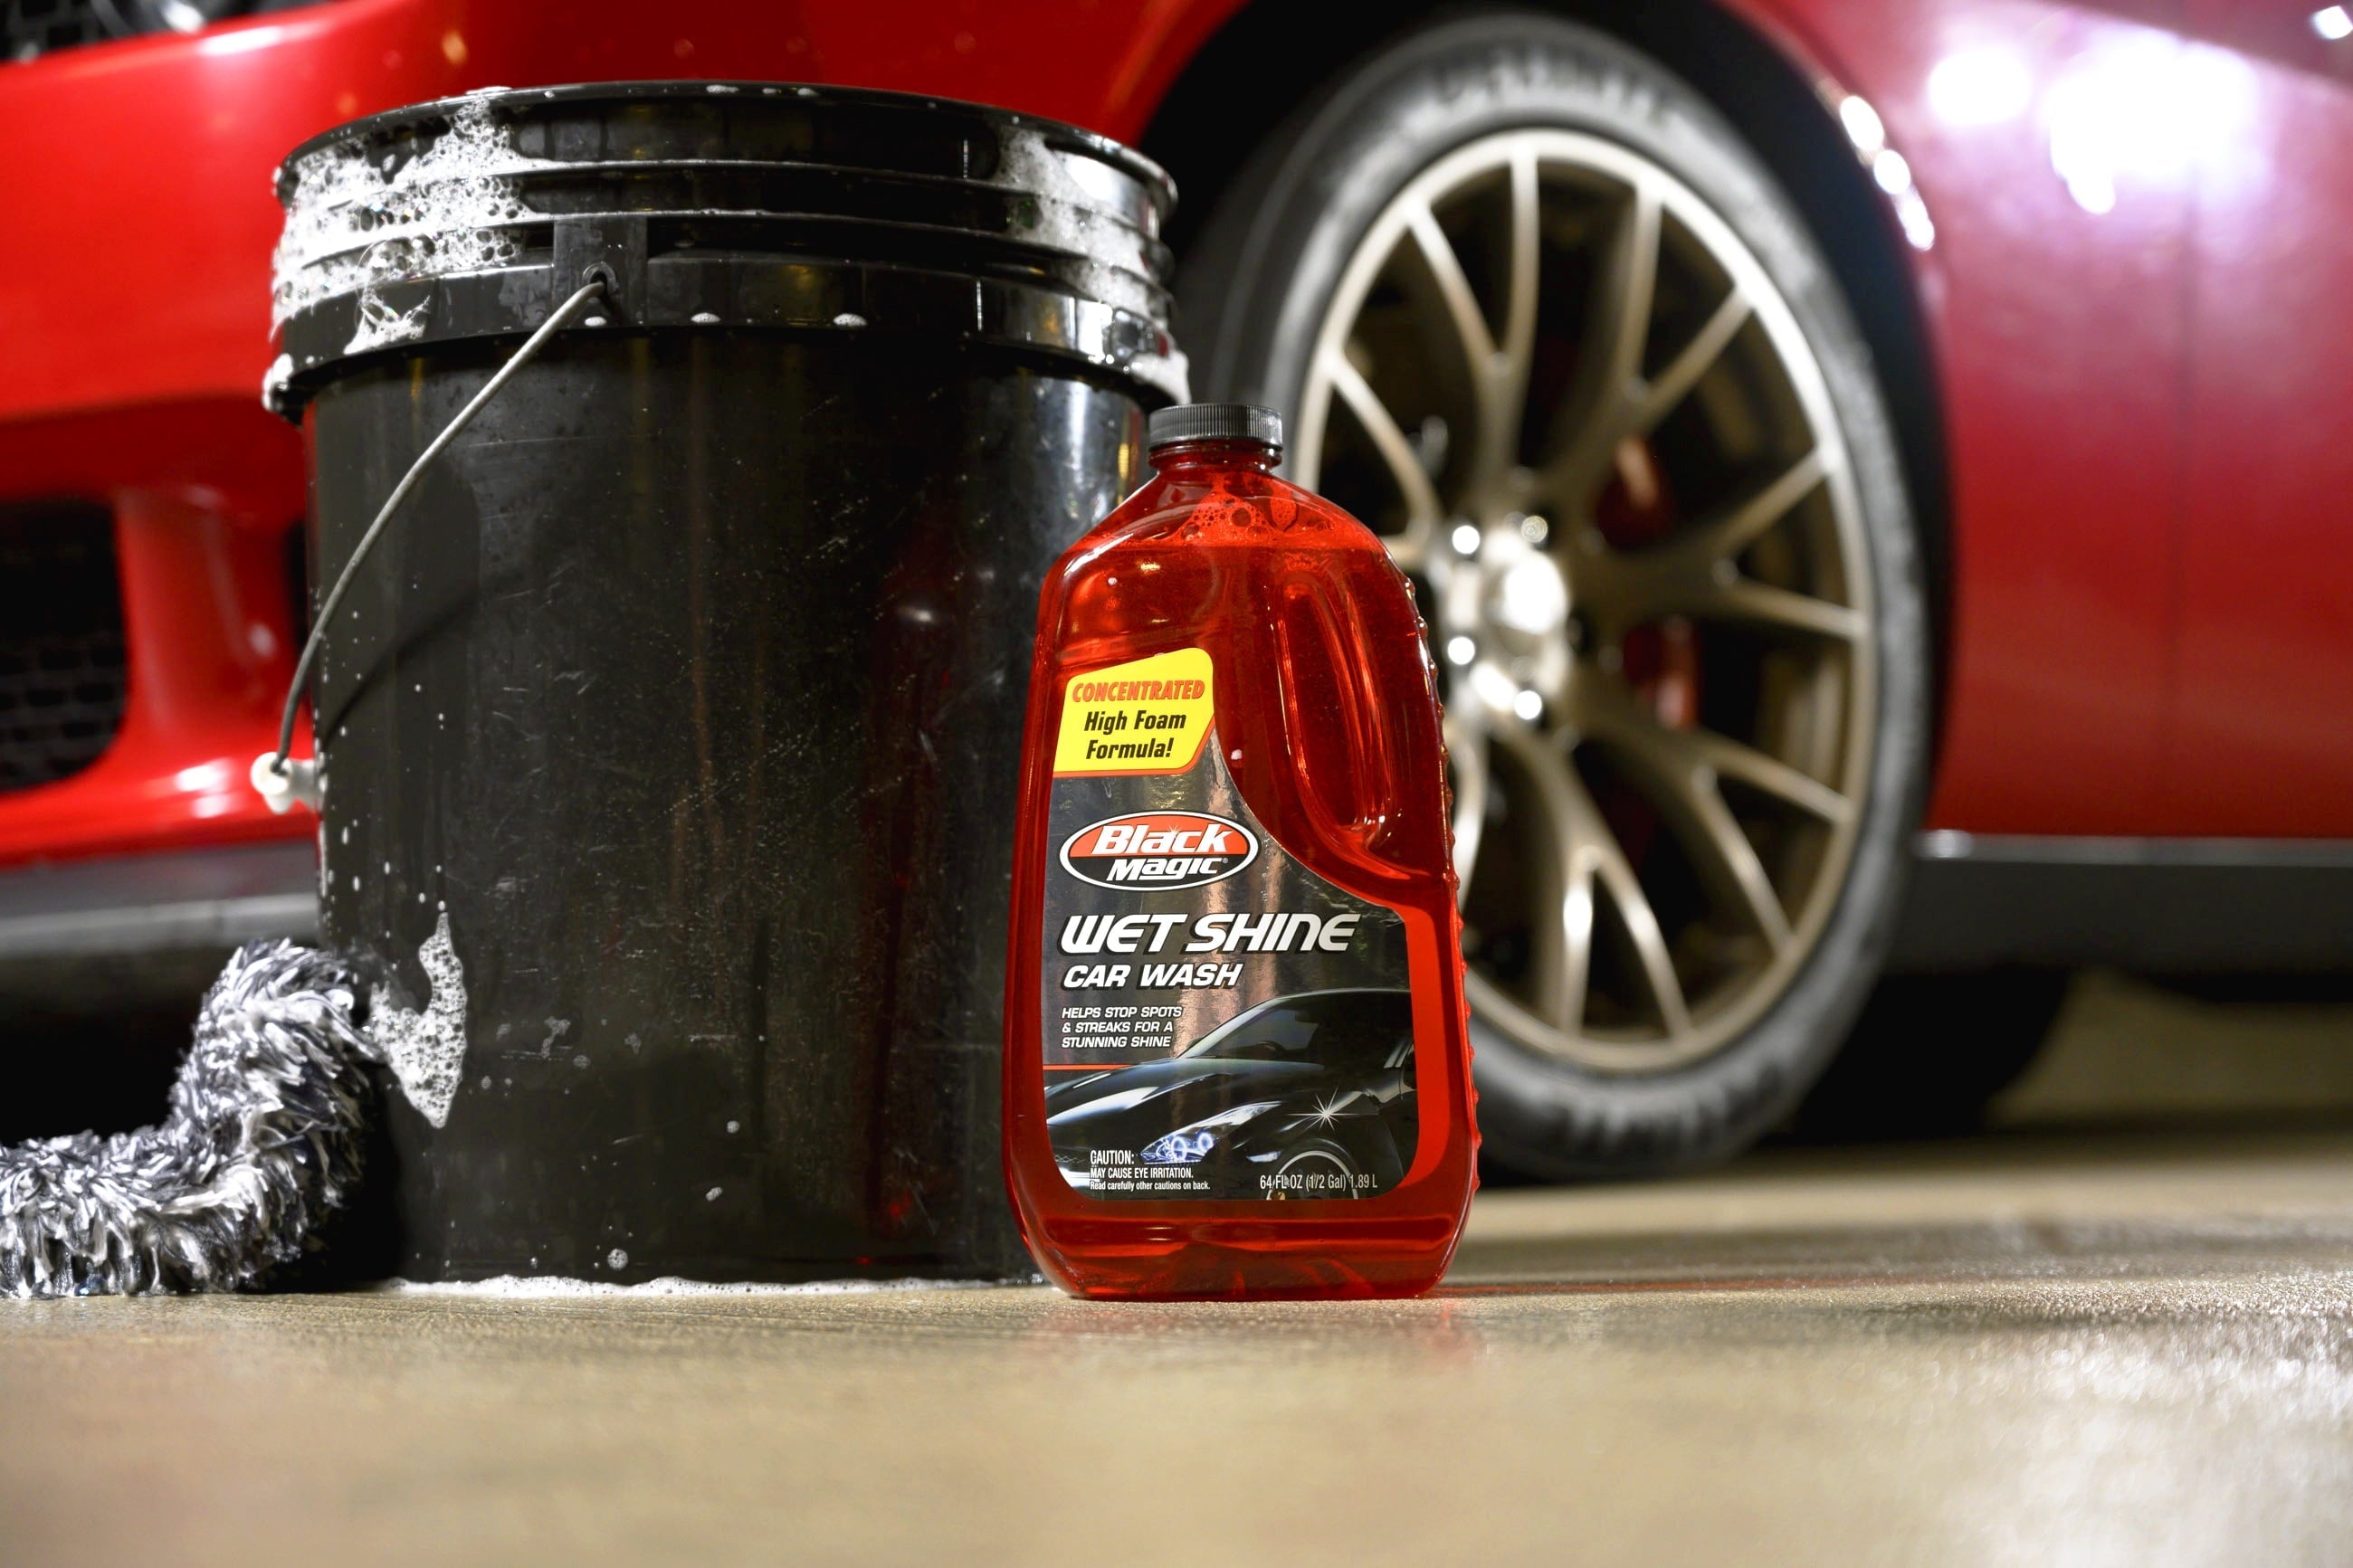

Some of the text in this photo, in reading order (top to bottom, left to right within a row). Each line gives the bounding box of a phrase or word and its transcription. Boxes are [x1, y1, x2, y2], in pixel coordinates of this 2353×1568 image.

[1072, 679, 1205, 703] CONCENTRATED
[1084, 710, 1186, 735] High Foam
[1086, 737, 1175, 760] Formula!
[1091, 823, 1234, 854] Black
[1060, 913, 1361, 955] WET SHINE
[1063, 963, 1244, 989] CAR WASH
[1062, 1006, 1183, 1019] HELPS STOP SPOTS
[1062, 1022, 1174, 1033] & STREAKS FOR A
[1062, 1036, 1172, 1048] STUNNING SHINE
[1090, 1150, 1135, 1165] CAUTION:
[1091, 1167, 1194, 1179] MAY CAUSE EYE IRRITATION.
[1090, 1181, 1106, 1190] Read
[1107, 1181, 1134, 1192] carefully
[1136, 1181, 1154, 1190] other
[1154, 1181, 1182, 1190] cautions
[1193, 1181, 1211, 1190] back.
[1260, 1174, 1378, 1192] 64 FL OZ (1/2 Gal) 1.89 L
